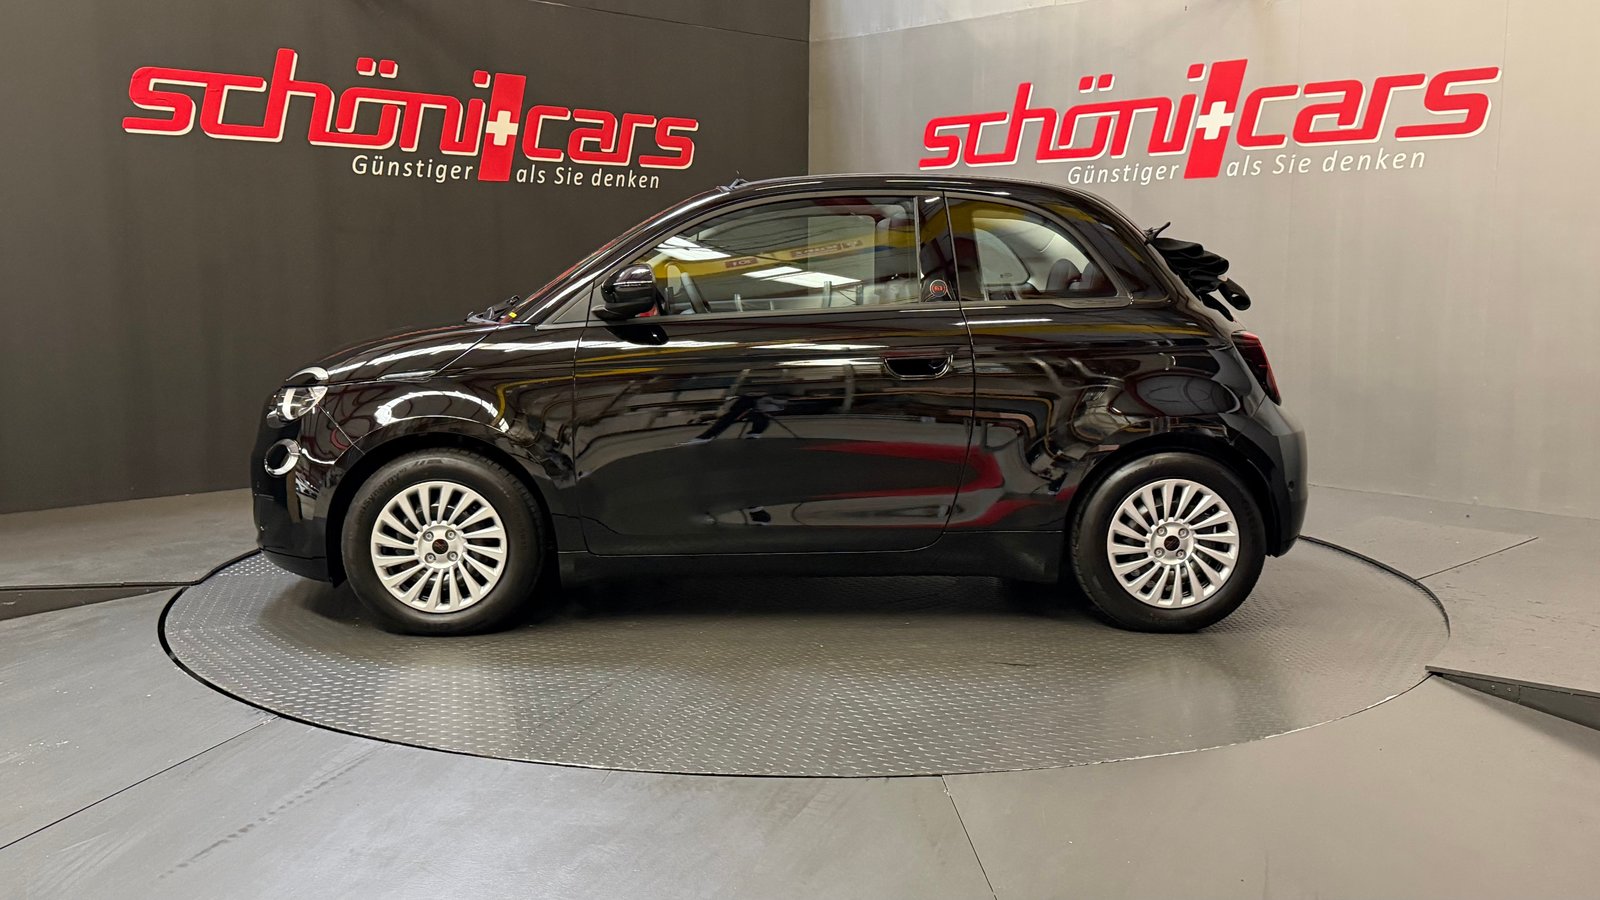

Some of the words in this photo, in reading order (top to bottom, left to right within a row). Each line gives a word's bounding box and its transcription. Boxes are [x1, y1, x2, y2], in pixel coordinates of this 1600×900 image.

[1235, 66, 1502, 149] cars
[521, 104, 700, 171] cars
[351, 154, 475, 184] Günstiger
[515, 164, 547, 185] als
[553, 165, 585, 187] Sie
[590, 168, 661, 190] denken
[1067, 162, 1181, 186] Günstiger
[1225, 154, 1263, 178] als
[1271, 153, 1312, 176] Sie
[1321, 147, 1427, 174] denken
